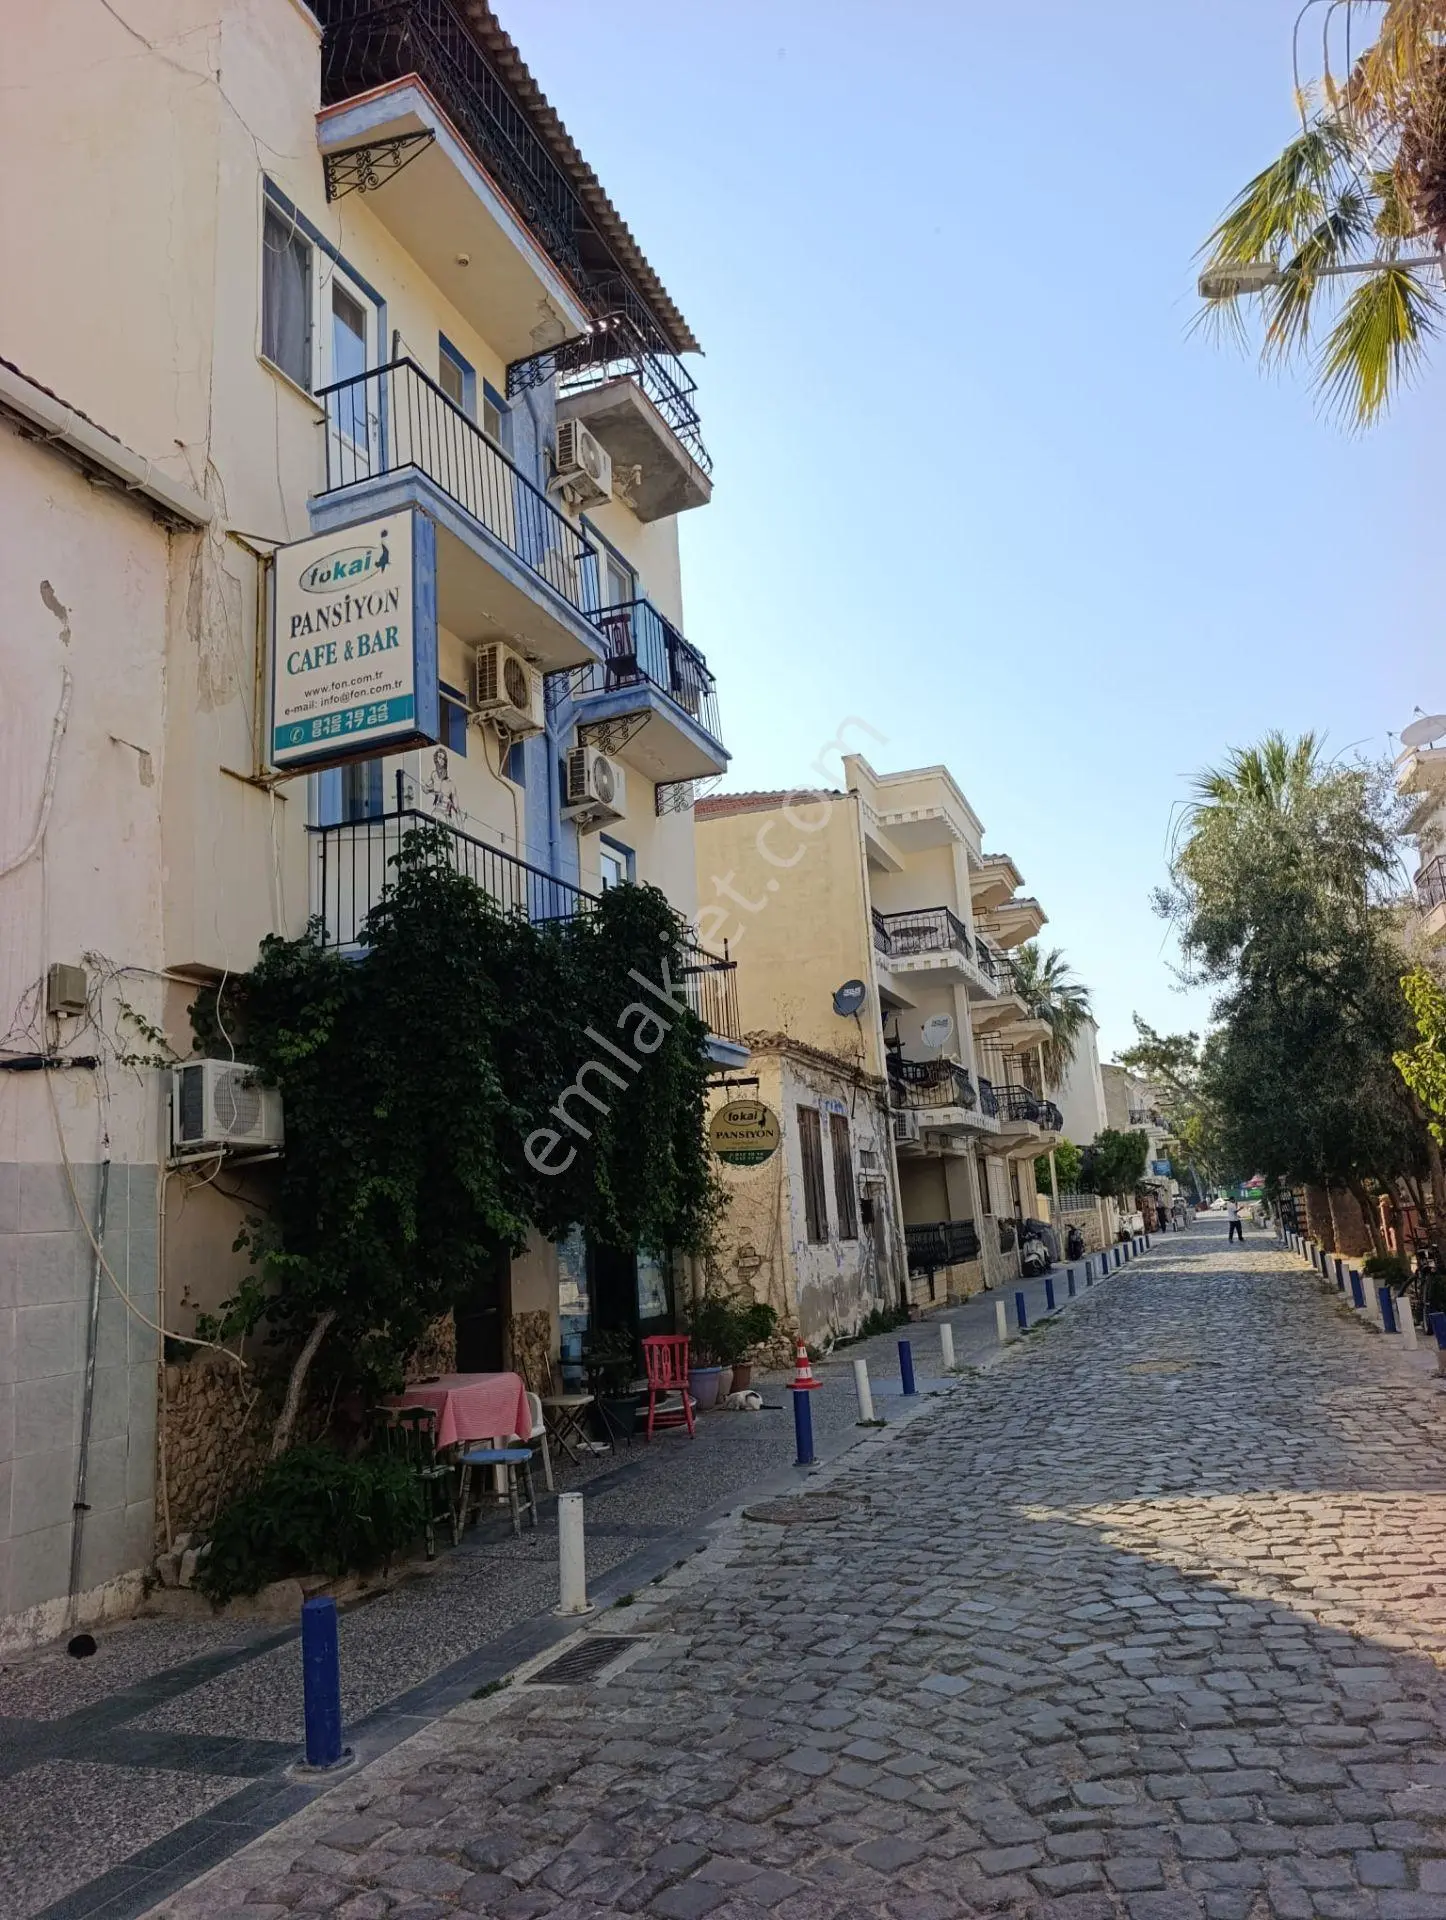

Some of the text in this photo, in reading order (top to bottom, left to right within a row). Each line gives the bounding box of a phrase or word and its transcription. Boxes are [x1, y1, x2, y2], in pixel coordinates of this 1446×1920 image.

[309, 551, 373, 587] fokai
[290, 587, 401, 639] PANSİYON
[287, 625, 400, 676] CAFE & BAR
[284, 680, 403, 716] e-mail: info@fon.com.tr
[304, 670, 383, 698] www.fon.com.tr
[345, 718, 364, 729] 17
[728, 1111, 758, 1121] fokai
